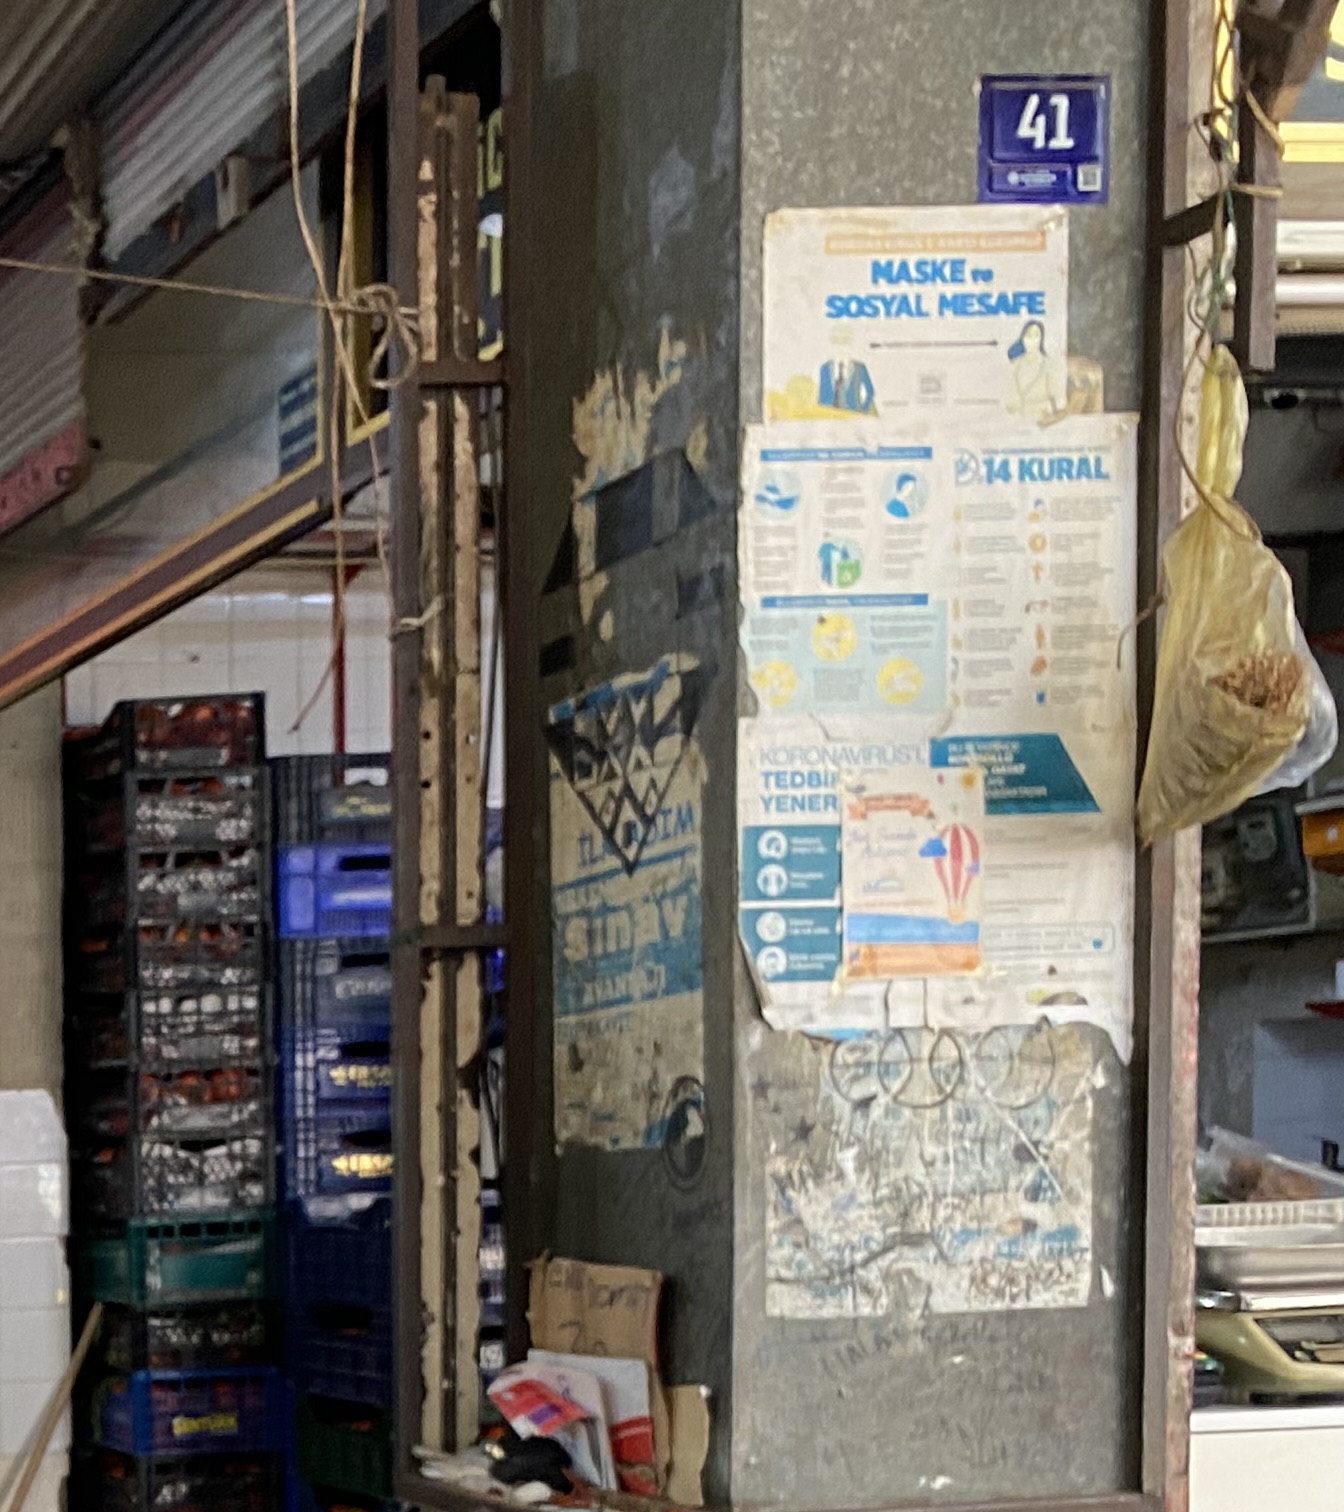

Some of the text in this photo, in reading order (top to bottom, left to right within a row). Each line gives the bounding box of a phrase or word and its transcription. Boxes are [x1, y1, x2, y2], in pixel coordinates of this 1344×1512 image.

[1016, 93, 1075, 150] 41
[871, 258, 966, 285] MASKE
[826, 291, 1046, 319] SOSYAL MESAFE
[983, 455, 1111, 484] 14 KURAL
